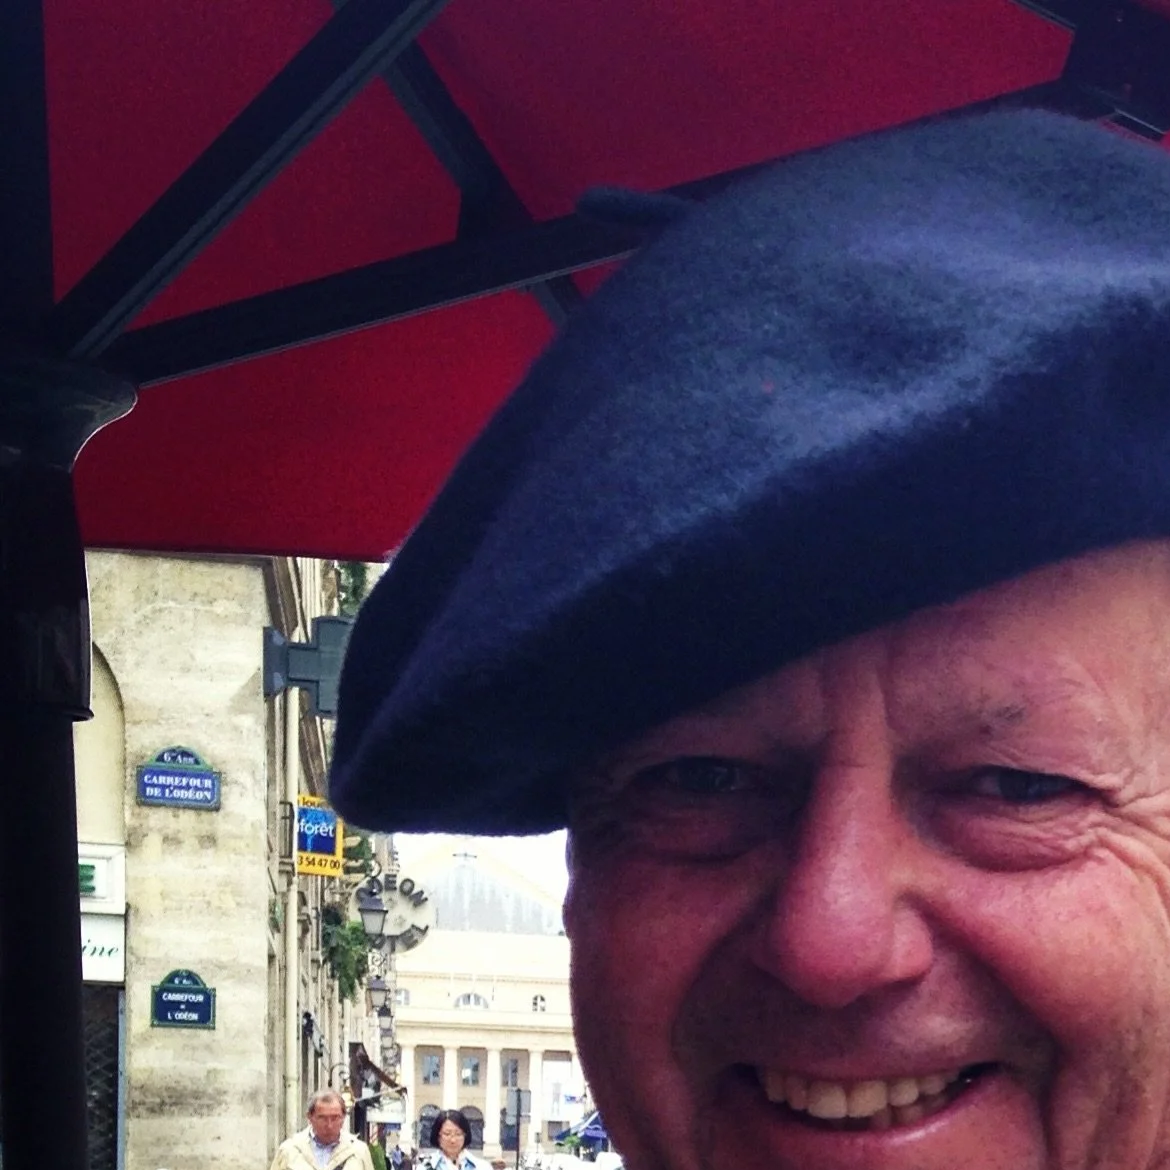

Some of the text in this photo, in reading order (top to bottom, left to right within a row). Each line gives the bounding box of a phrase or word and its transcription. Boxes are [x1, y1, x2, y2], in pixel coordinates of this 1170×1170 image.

[143, 774, 213, 789] CARREFOUR
[145, 786, 162, 797] DE
[296, 818, 335, 838] forêt
[305, 857, 316, 867] 54
[317, 858, 329, 868] 47
[329, 859, 341, 870] 00
[162, 992, 204, 1002] CARREFOUR
